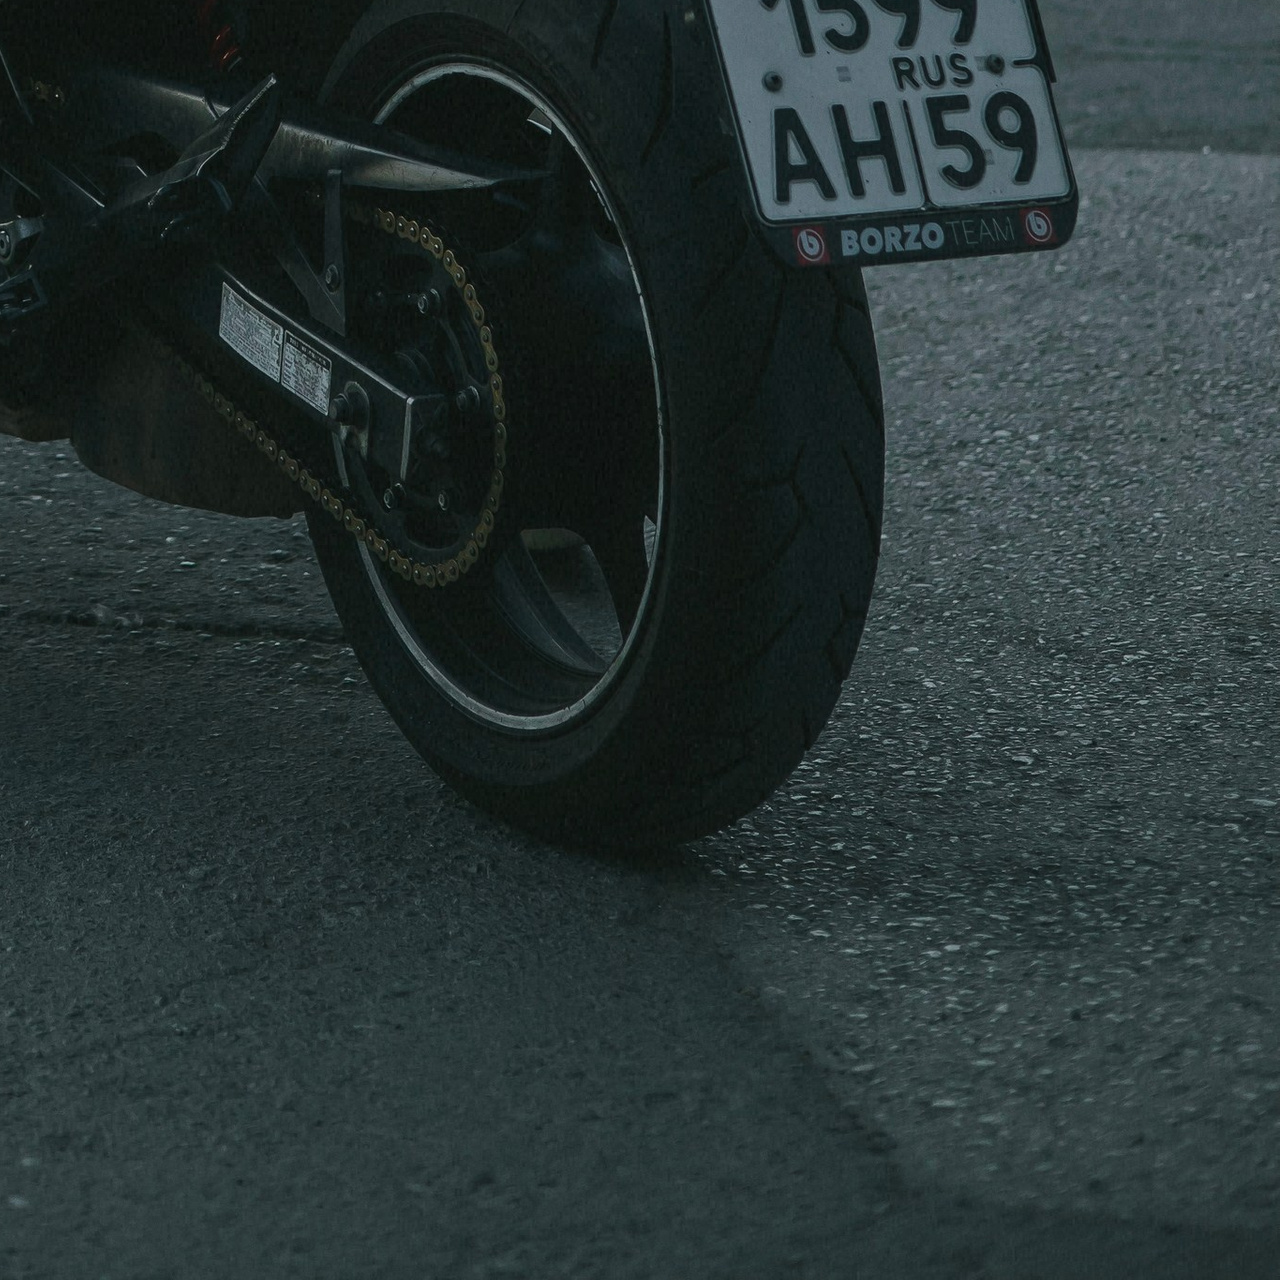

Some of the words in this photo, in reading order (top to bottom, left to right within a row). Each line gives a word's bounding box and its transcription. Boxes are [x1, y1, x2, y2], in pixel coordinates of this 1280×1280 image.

[891, 52, 974, 90] RUS
[925, 91, 1037, 189] 59
[841, 222, 944, 257] BORZO
[945, 216, 1016, 246] TEAM
